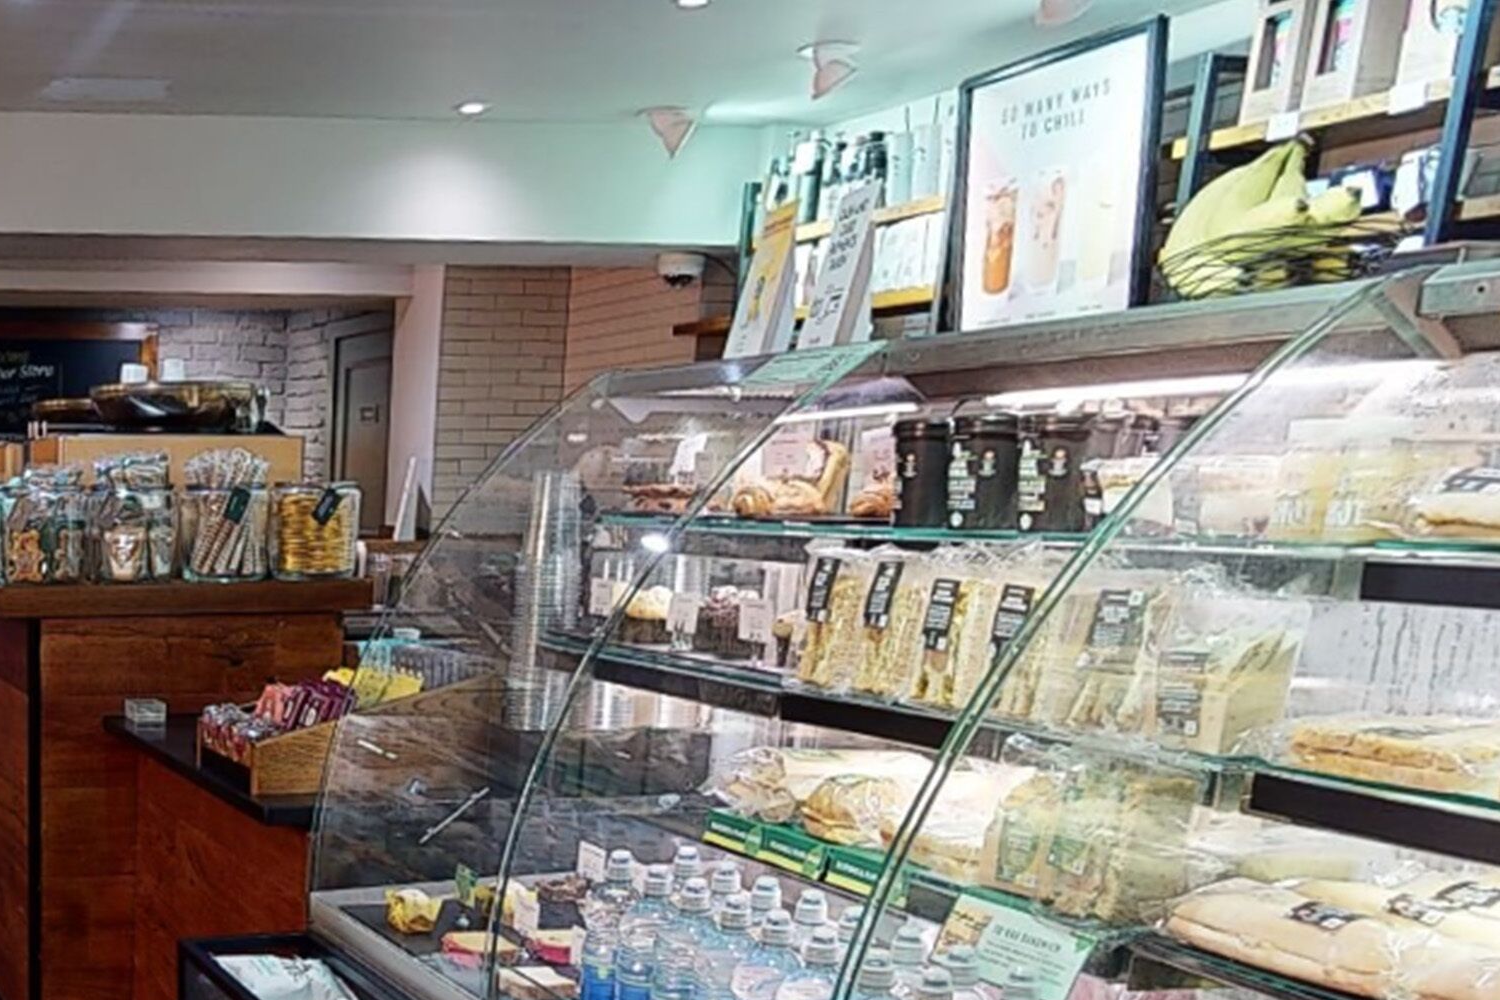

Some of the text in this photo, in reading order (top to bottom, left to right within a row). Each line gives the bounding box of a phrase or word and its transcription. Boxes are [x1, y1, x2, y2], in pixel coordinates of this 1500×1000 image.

[1001, 79, 1111, 126] SO MANY WAYS
[1021, 109, 1085, 141] TO CHILL
